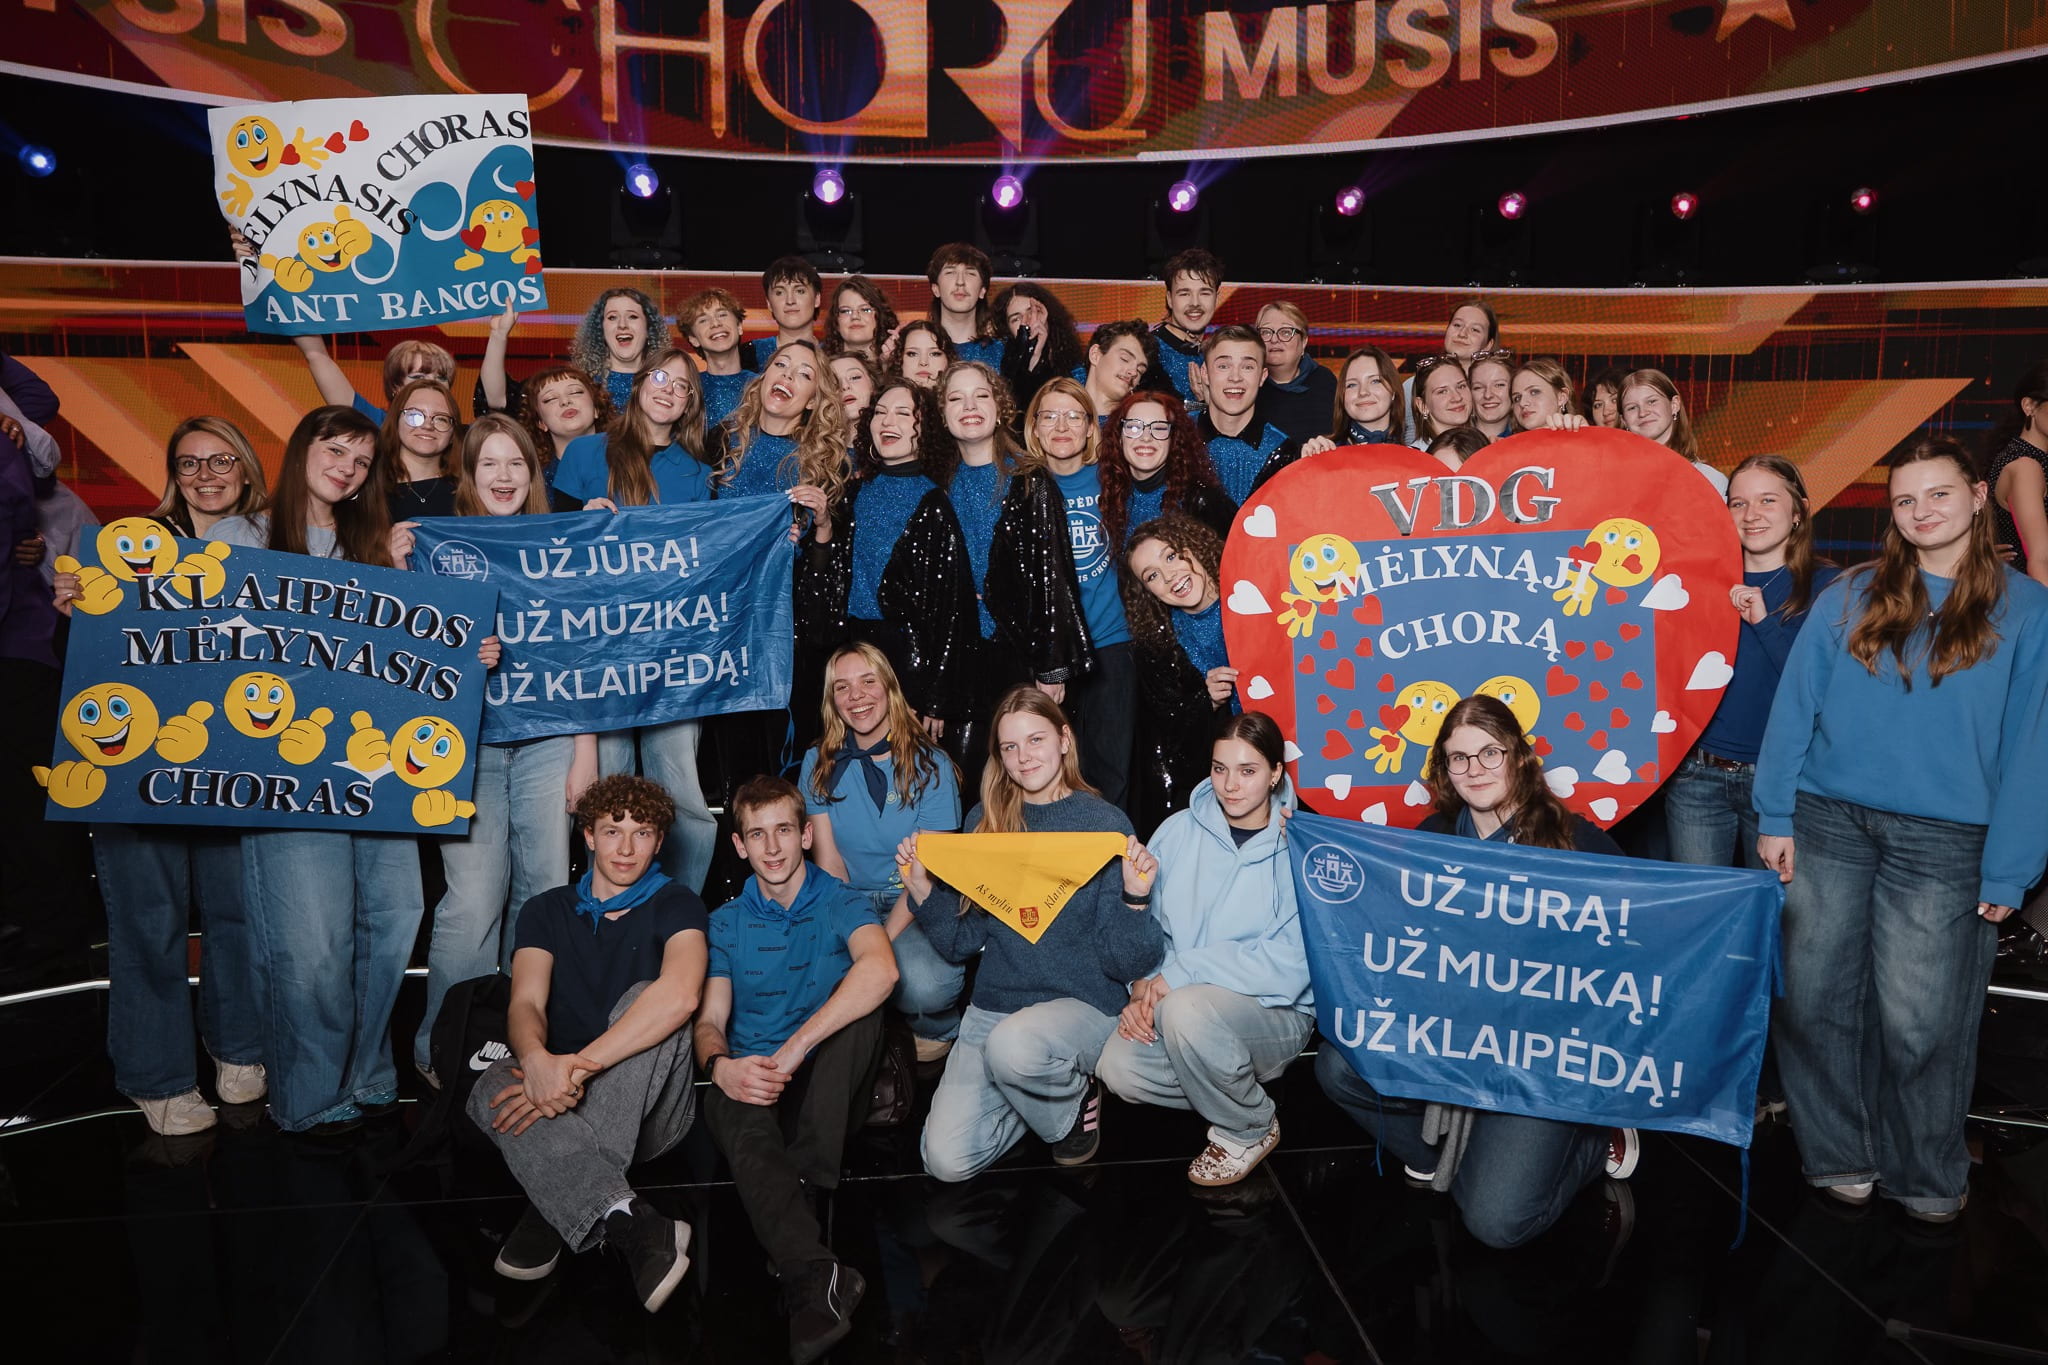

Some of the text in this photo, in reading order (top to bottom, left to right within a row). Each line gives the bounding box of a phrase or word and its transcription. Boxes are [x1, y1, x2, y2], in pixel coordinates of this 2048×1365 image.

[377, 109, 529, 182] CHORAS
[265, 276, 541, 324] ANT BANGOS
[1369, 465, 1562, 536] VDG
[518, 535, 700, 580] UŽ JŪRĄ!
[1328, 544, 1598, 602] MĖLYNĄJĮ
[134, 573, 475, 648] KLAIPĖDOS
[497, 591, 730, 644] UŽ MUZIKĄ!
[1378, 609, 1562, 662] CHORĄ
[121, 616, 464, 701] MĖLYNASIS
[485, 645, 750, 706] UŽ KLAIPĖDĄ!
[138, 767, 374, 818] CHORAS
[1400, 864, 1632, 947] UŽ JŪRĄ!
[1363, 926, 1663, 1027] UŽ MUZIKĄ!
[1334, 997, 1685, 1108] UŽ KLAIPĖDĄ!
